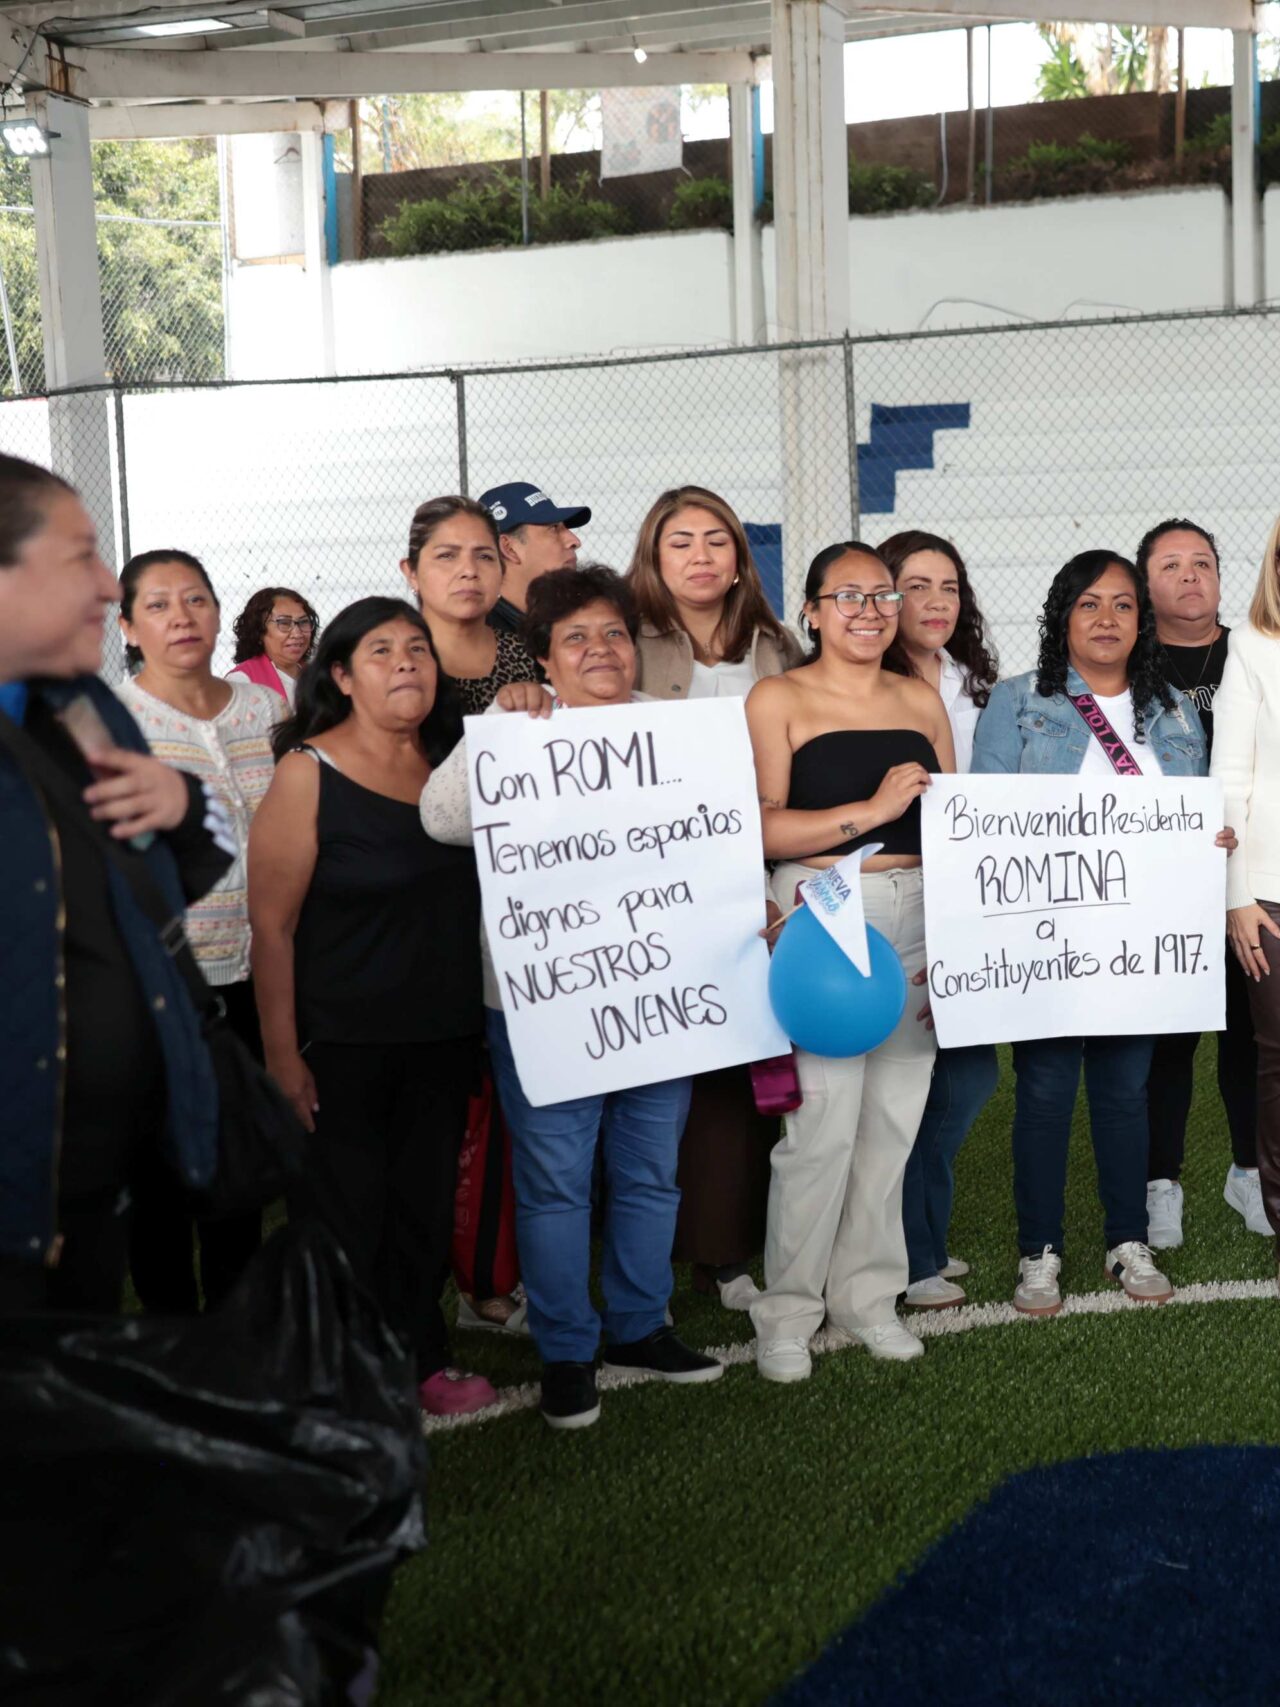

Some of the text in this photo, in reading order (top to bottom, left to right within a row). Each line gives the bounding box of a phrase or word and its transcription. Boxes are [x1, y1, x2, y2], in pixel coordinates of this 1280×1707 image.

[1077, 696, 1112, 736] LOLA
[1104, 742, 1121, 755] Y
[475, 751, 539, 805] Con
[474, 804, 742, 874] Tenemos espacios
[945, 793, 1204, 841] Bienvenida Presidenta
[974, 849, 1128, 906] ROMINA
[499, 880, 693, 950] dignos para
[1036, 918, 1056, 942] a
[505, 932, 671, 1011] NUESTROS
[930, 933, 1210, 998] Constituyentes de 1917.
[585, 984, 727, 1061] JOVENES
